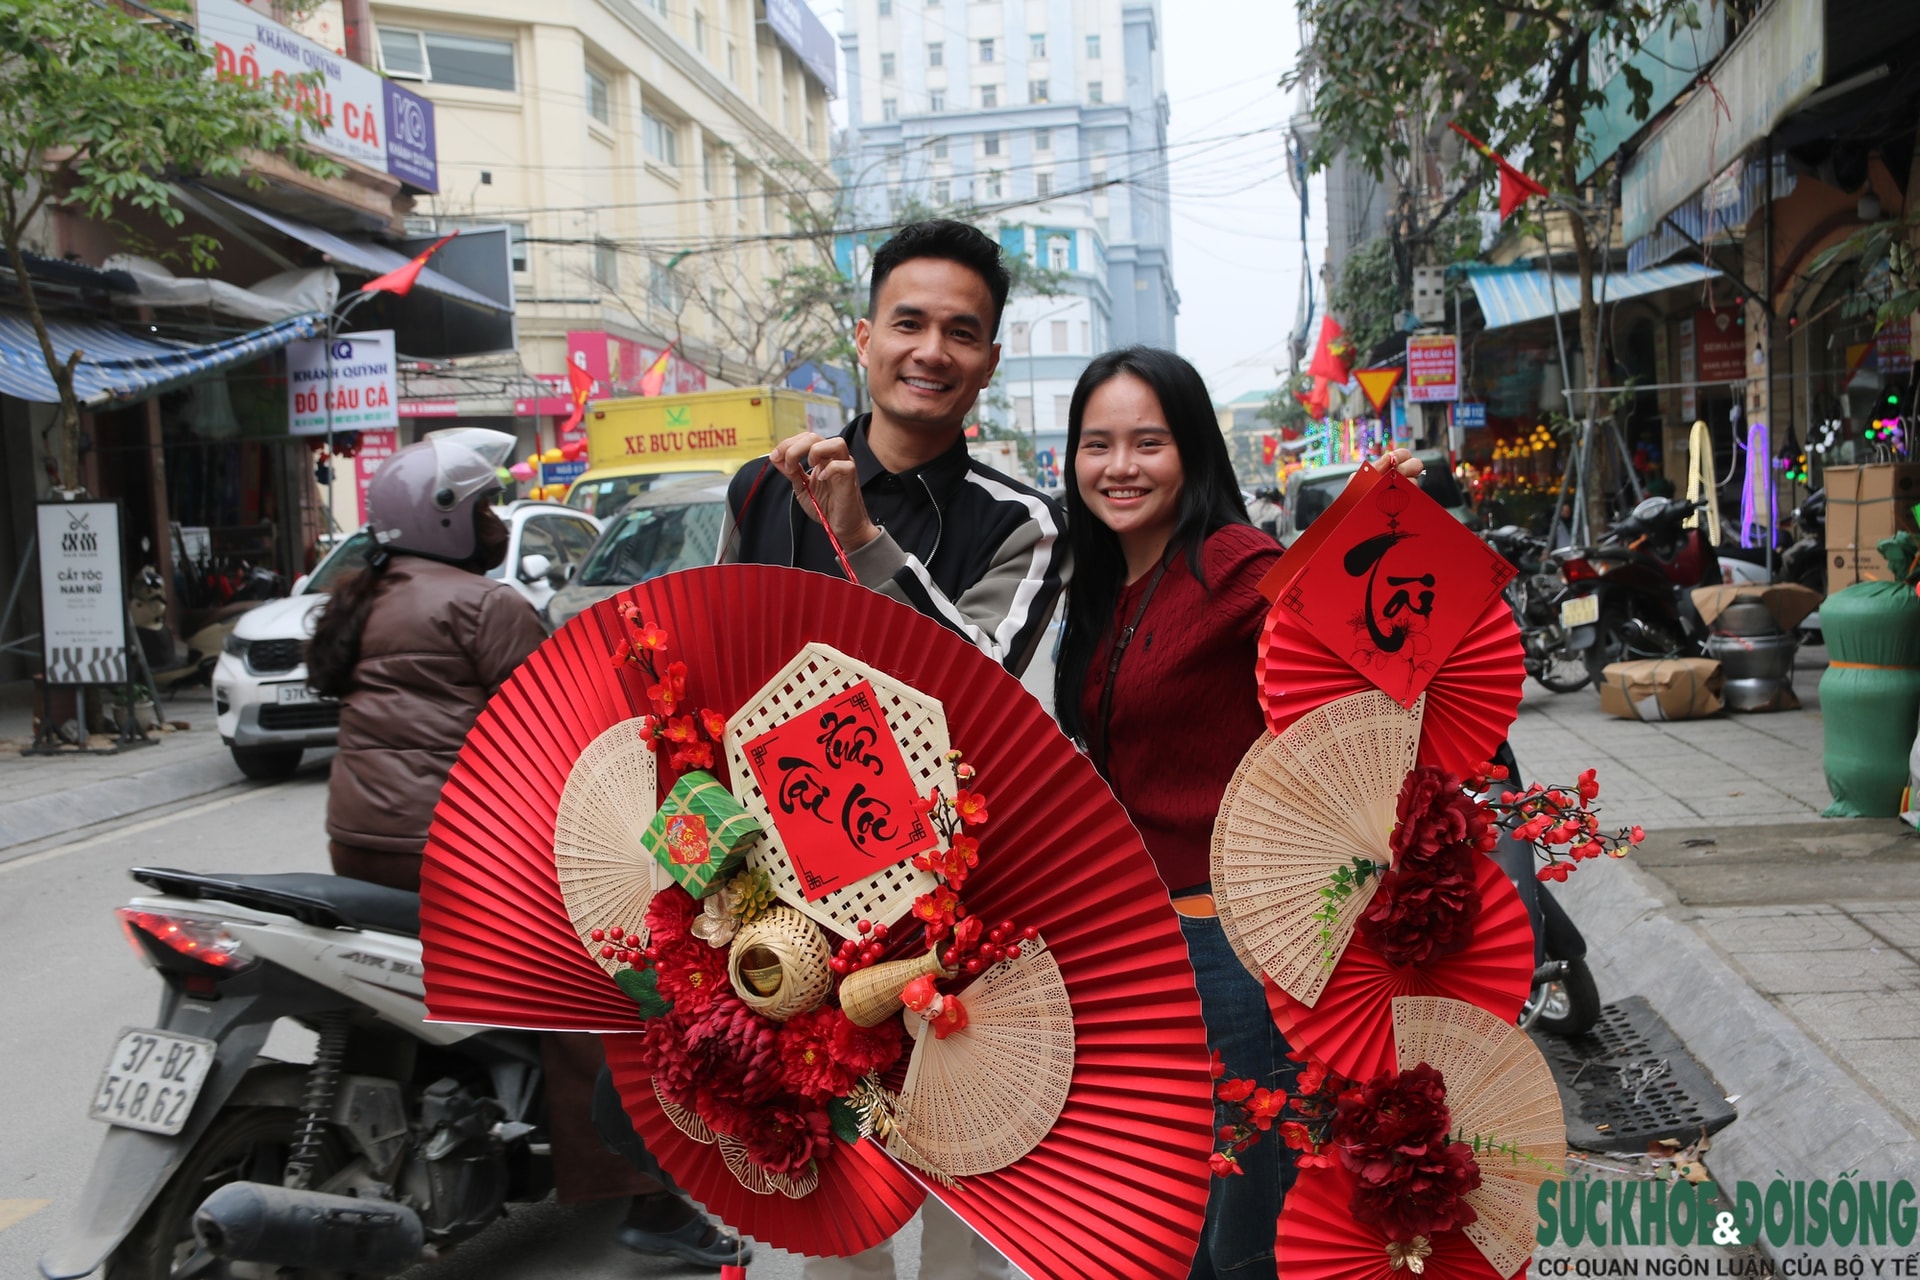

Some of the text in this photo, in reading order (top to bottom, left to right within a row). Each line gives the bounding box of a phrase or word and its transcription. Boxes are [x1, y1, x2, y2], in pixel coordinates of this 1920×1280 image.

[257, 25, 342, 82] KHÁNH QUỲNH
[342, 104, 380, 149] CÁ
[293, 362, 388, 382] KHÁNH QUỲNH
[324, 385, 359, 411] CÂU
[366, 380, 389, 408] CÁ
[624, 424, 737, 455] XE BƯU CHÍNH
[60, 582, 103, 595] NAM NỮ
[122, 1034, 196, 1082] 37-B2
[97, 1075, 187, 1127] 548.62
